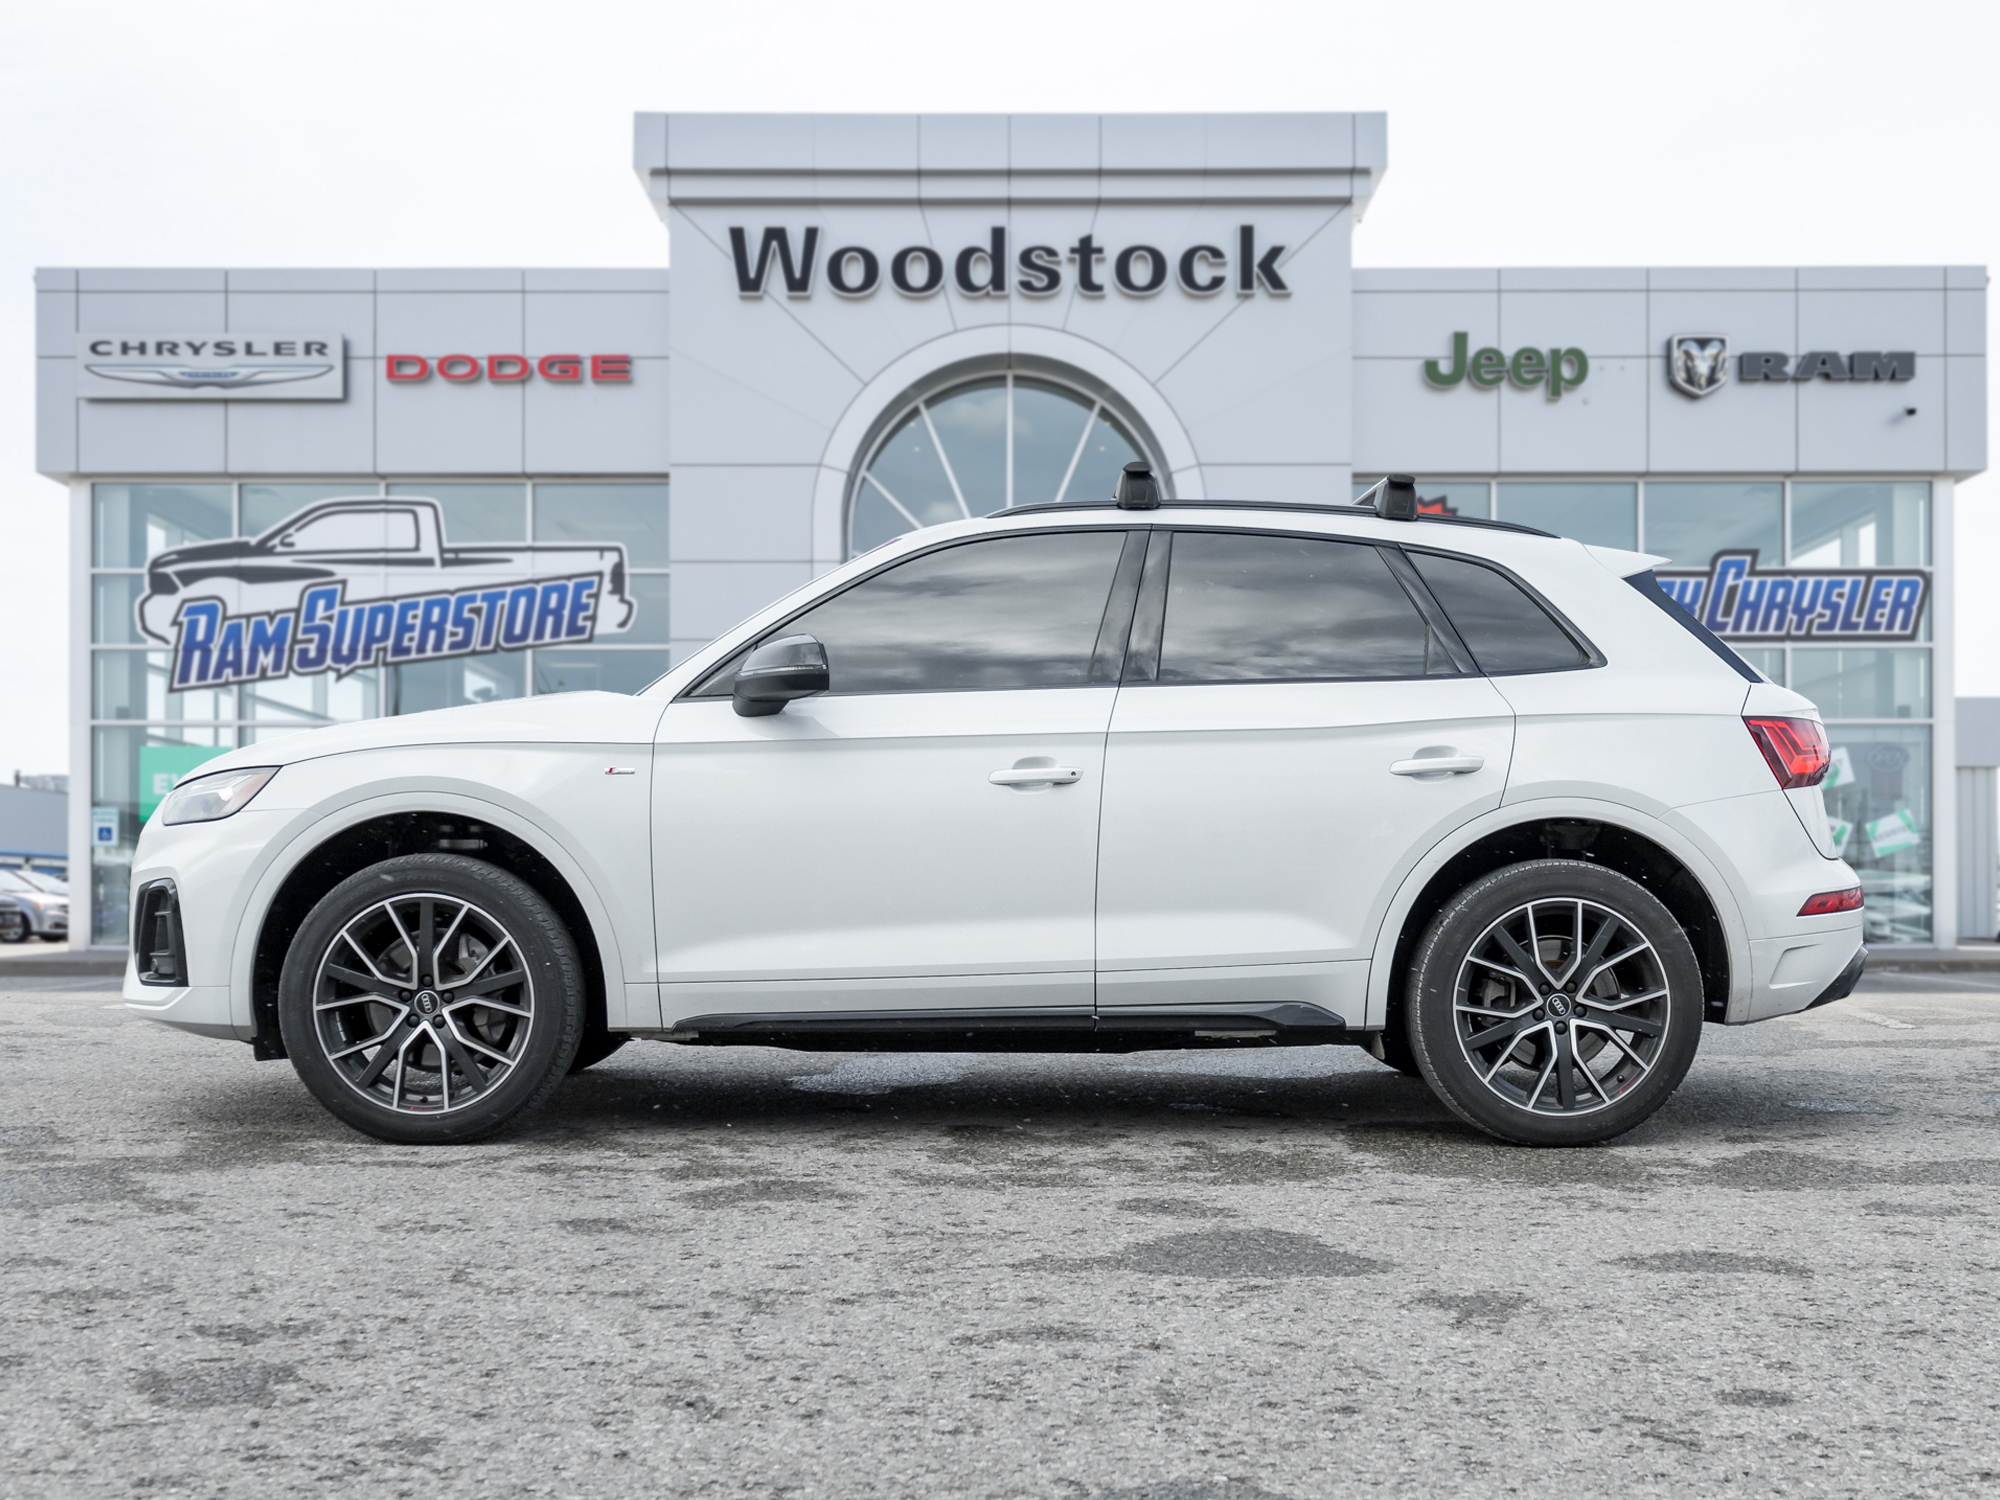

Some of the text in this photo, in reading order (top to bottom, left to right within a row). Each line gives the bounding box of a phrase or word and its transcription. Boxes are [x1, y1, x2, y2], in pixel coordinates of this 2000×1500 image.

[727, 224, 1292, 296] Woodstock
[89, 340, 329, 357] CHRYSLER
[386, 354, 632, 381] DODGE
[1424, 331, 1589, 398] Jeep
[1739, 351, 1916, 381] RAM
[1704, 557, 1922, 634] CHRYSLER
[175, 578, 597, 686] RAM SUPERSTORE
